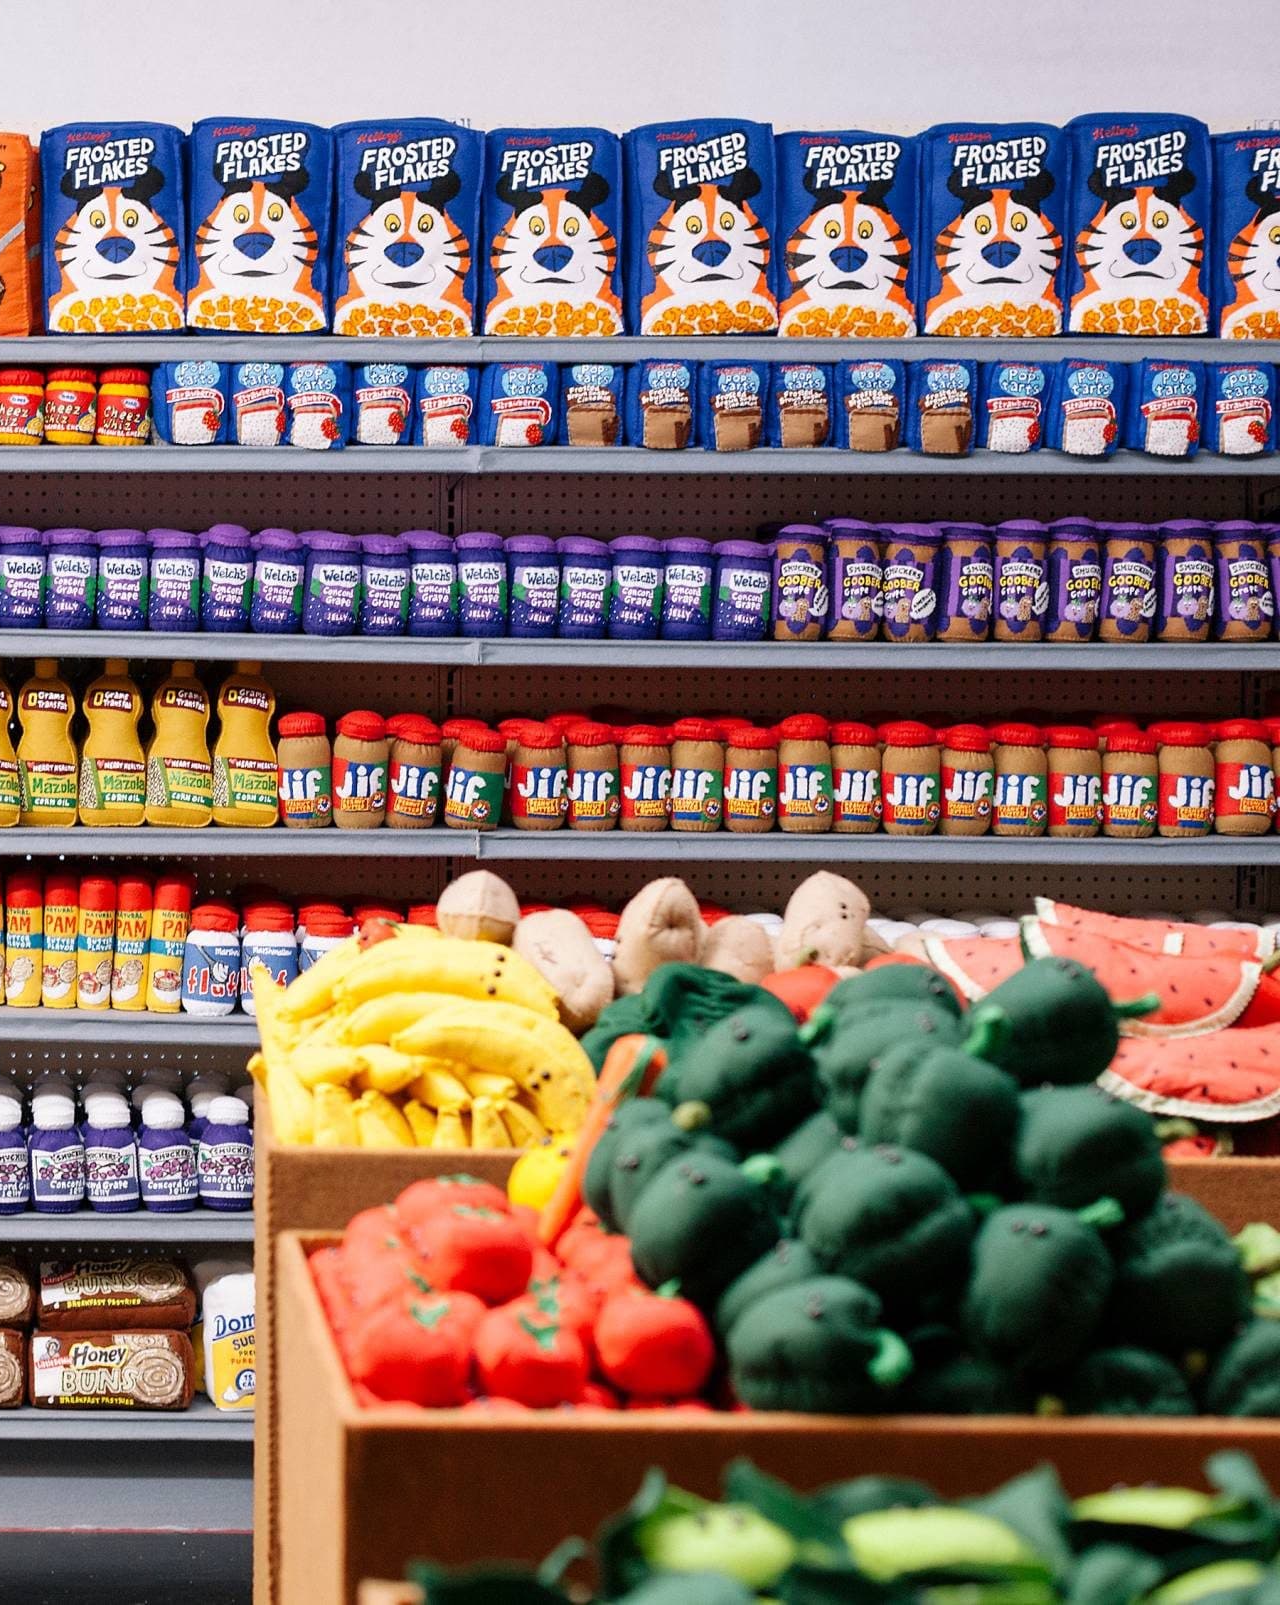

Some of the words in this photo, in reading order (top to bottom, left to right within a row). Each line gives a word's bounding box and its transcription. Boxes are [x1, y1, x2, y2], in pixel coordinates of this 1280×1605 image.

[67, 139, 154, 170] FROSTED
[217, 133, 306, 164] FROSTED
[361, 137, 455, 171] FROSTED
[501, 143, 593, 172] FROSTED
[660, 133, 745, 170] FROSTED
[805, 142, 900, 171] FROSTED
[954, 137, 1046, 167] FROSTED
[1096, 131, 1186, 167] FROSTED
[75, 159, 148, 188] FLAKES
[223, 153, 300, 182] FLAKES
[375, 159, 449, 190] FLAKES
[512, 160, 589, 190] FLAKES
[672, 152, 747, 189] FLAKES
[816, 162, 895, 188] FLAKES
[962, 157, 1041, 187] FLAKES
[1106, 153, 1183, 186] FLAKES
[297, 381, 336, 395] tarts
[509, 382, 546, 397] tarts
[1072, 381, 1111, 395] tarts
[104, 406, 140, 421] Cheez
[106, 561, 142, 575] Welch's
[211, 566, 246, 579] Welch's
[464, 566, 500, 581] Welch's
[105, 579, 139, 591] Concord
[211, 583, 243, 595] Concord
[778, 576, 821, 590] GOOBER
[1000, 576, 1040, 588] GOOBER
[1109, 576, 1150, 590] GOOBER
[111, 590, 138, 602] Grape
[216, 594, 241, 604] Grape
[32, 776, 76, 794] Mazola
[104, 775, 144, 792] Mazola
[279, 769, 322, 801] Jif
[336, 765, 384, 799] Jif
[780, 767, 825, 805] Jif
[886, 773, 934, 806] Jif
[1054, 774, 1101, 806] Jif
[3, 794, 18, 803] OIL
[34, 796, 54, 806] CORN
[56, 797, 70, 807] OIL
[45, 914, 77, 935] PAM
[84, 917, 113, 936] PAM
[72, 1343, 126, 1367] Honey
[61, 1368, 137, 1396] BUNS
